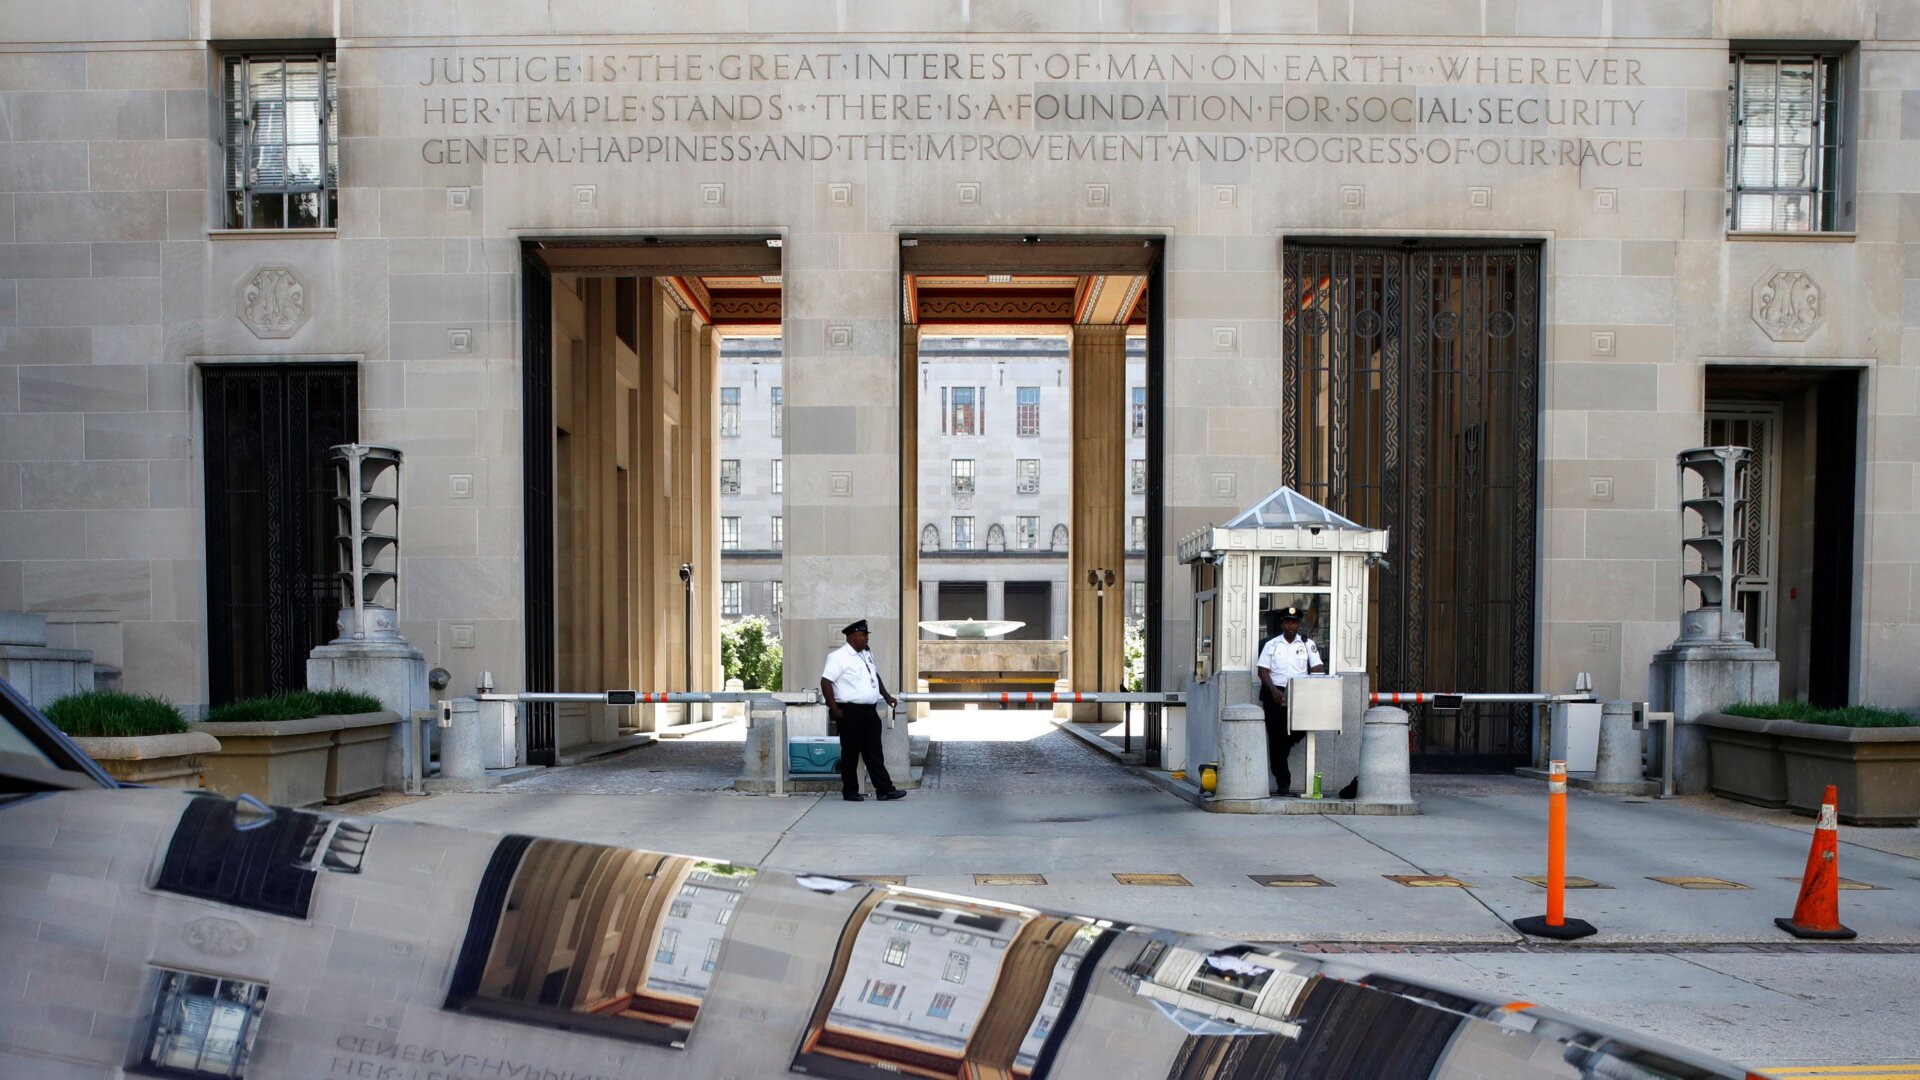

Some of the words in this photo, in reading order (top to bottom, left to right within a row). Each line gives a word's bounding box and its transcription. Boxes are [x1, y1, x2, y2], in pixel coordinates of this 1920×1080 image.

[420, 57, 571, 86] JUSTICE
[588, 56, 618, 82] IS
[627, 55, 703, 82] THE
[719, 55, 841, 81] GREAT
[855, 53, 1032, 80] INTEREST
[1044, 53, 1091, 80] OF
[1107, 54, 1194, 81] MAN
[1211, 54, 1266, 82] ON
[1285, 55, 1402, 83] EARTH
[1435, 56, 1646, 85] WHEREVER
[423, 98, 494, 124] HER
[502, 96, 637, 123] TEMPLE
[651, 95, 784, 121] STANDS
[816, 94, 932, 120] THERE
[946, 94, 971, 120] IS
[984, 94, 1006, 120] A
[1017, 94, 1254, 122] FOUNDATION
[1268, 96, 1336, 124] FOR
[1346, 97, 1467, 125] SOCIAL
[1479, 98, 1644, 126] SECURITY
[422, 137, 573, 165] GENERAL
[579, 136, 752, 163] HAPPINESS
[760, 135, 834, 162] AND
[838, 135, 907, 160] THE
[915, 134, 1168, 162] IMPROVEMENT
[1171, 135, 1246, 162] AND
[1256, 136, 1419, 164] PROGRESS
[1426, 137, 1470, 165] OF
[1477, 138, 1549, 166] OUR
[1559, 138, 1643, 168] RACE
